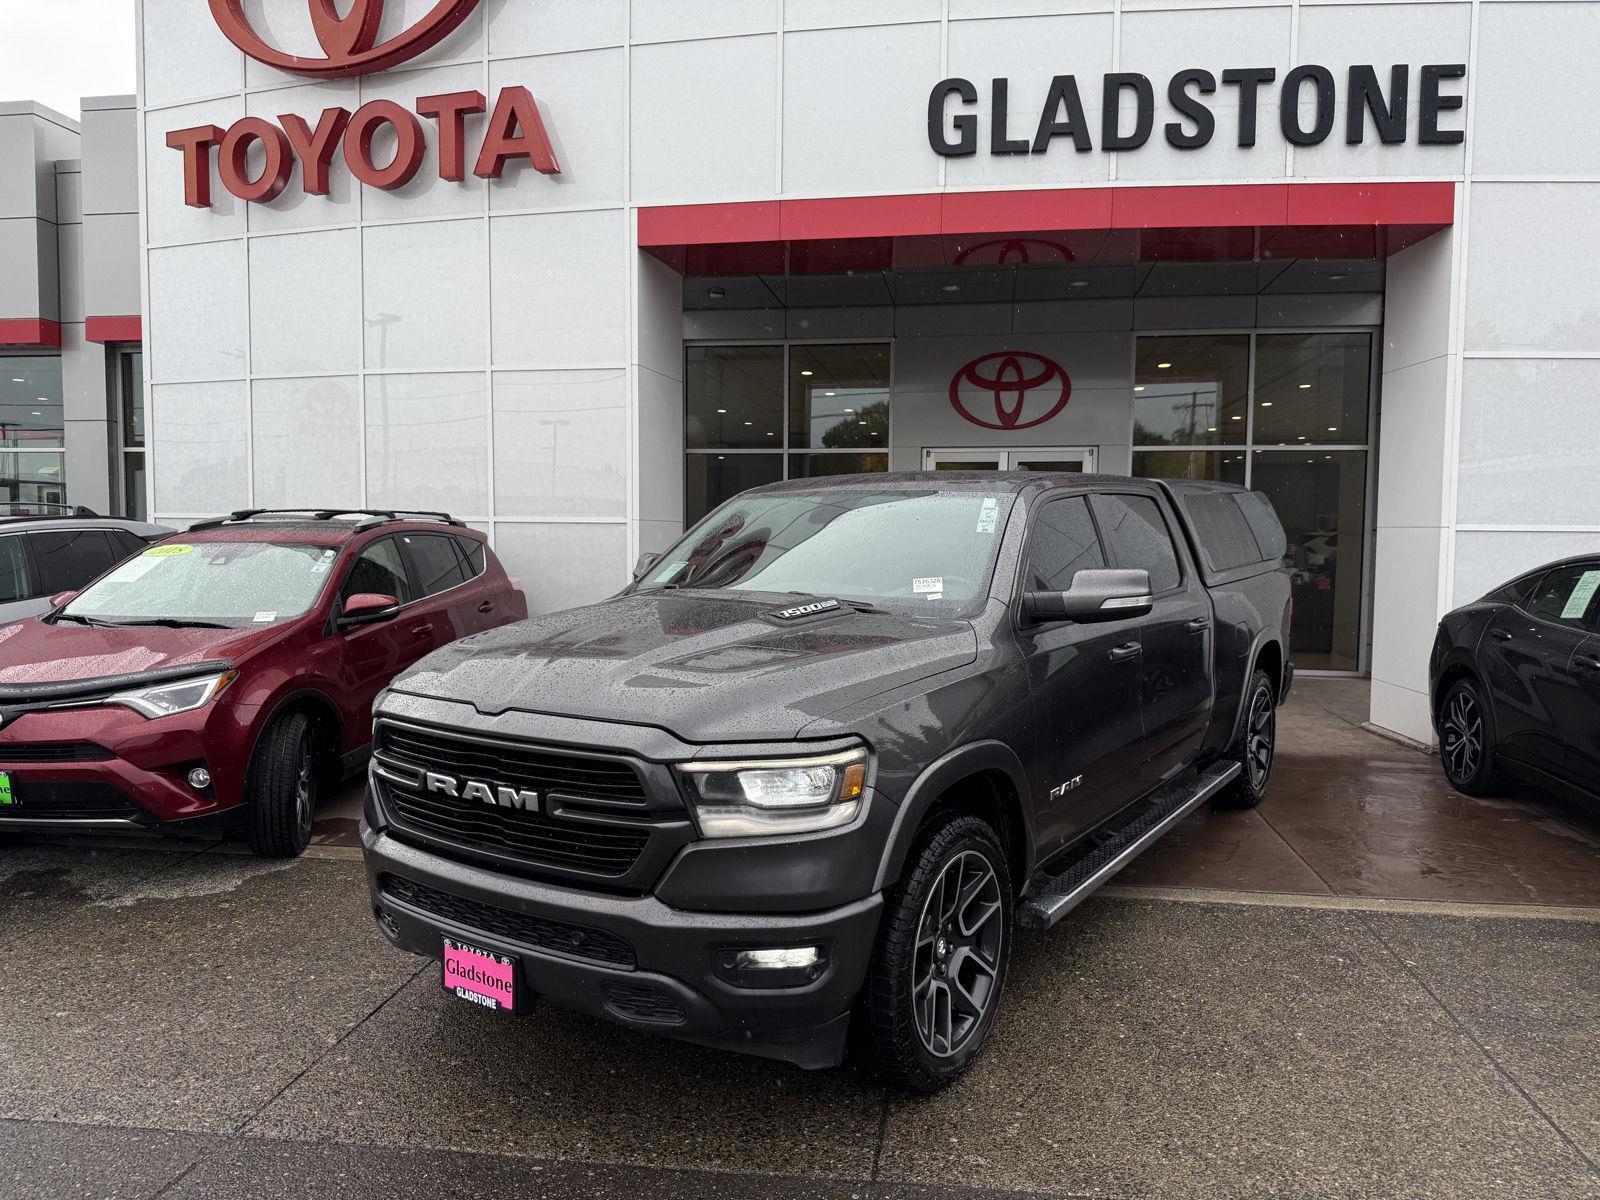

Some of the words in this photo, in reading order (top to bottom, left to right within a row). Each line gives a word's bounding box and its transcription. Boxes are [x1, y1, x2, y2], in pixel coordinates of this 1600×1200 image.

[928, 64, 1467, 157] GLADSTONE
[166, 85, 561, 208] TOYOTA
[780, 602, 822, 617] 1500
[427, 772, 539, 813] RAM
[456, 942, 496, 961] TOYOTA
[446, 958, 513, 993] Gladstone
[456, 986, 497, 1009] GLADSTONE
